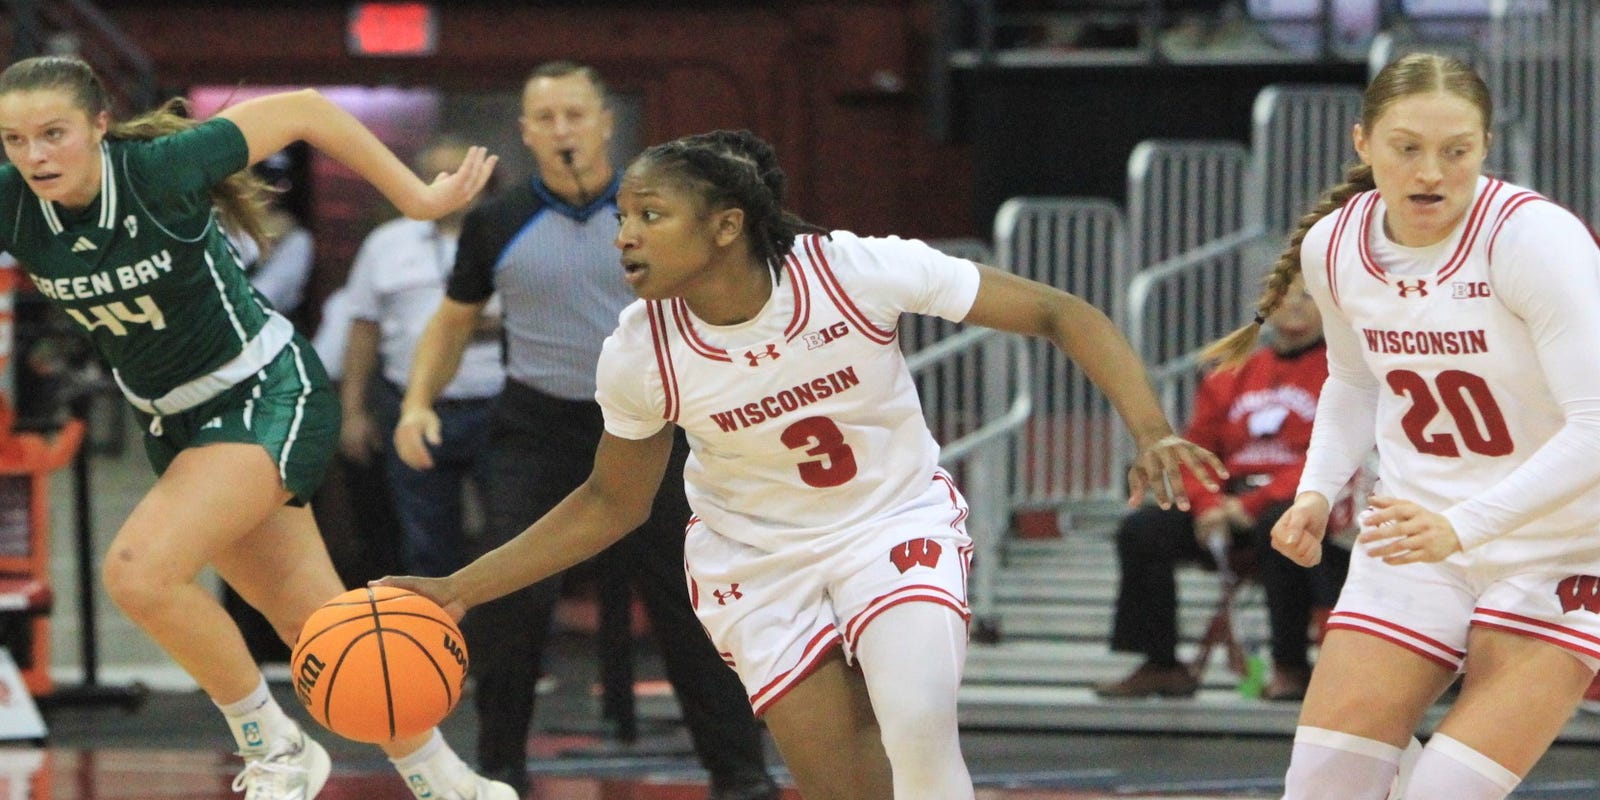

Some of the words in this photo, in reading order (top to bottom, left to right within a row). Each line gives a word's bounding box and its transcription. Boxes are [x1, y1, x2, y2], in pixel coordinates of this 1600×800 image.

[116, 250, 173, 290] BAY
[65, 295, 167, 336] 44
[1363, 328, 1489, 355] WISCONSIN
[709, 366, 860, 433] WISCONSIN
[1386, 369, 1515, 458] 20
[780, 415, 858, 489] 3
[890, 537, 942, 574] W
[1555, 574, 1600, 615] W
